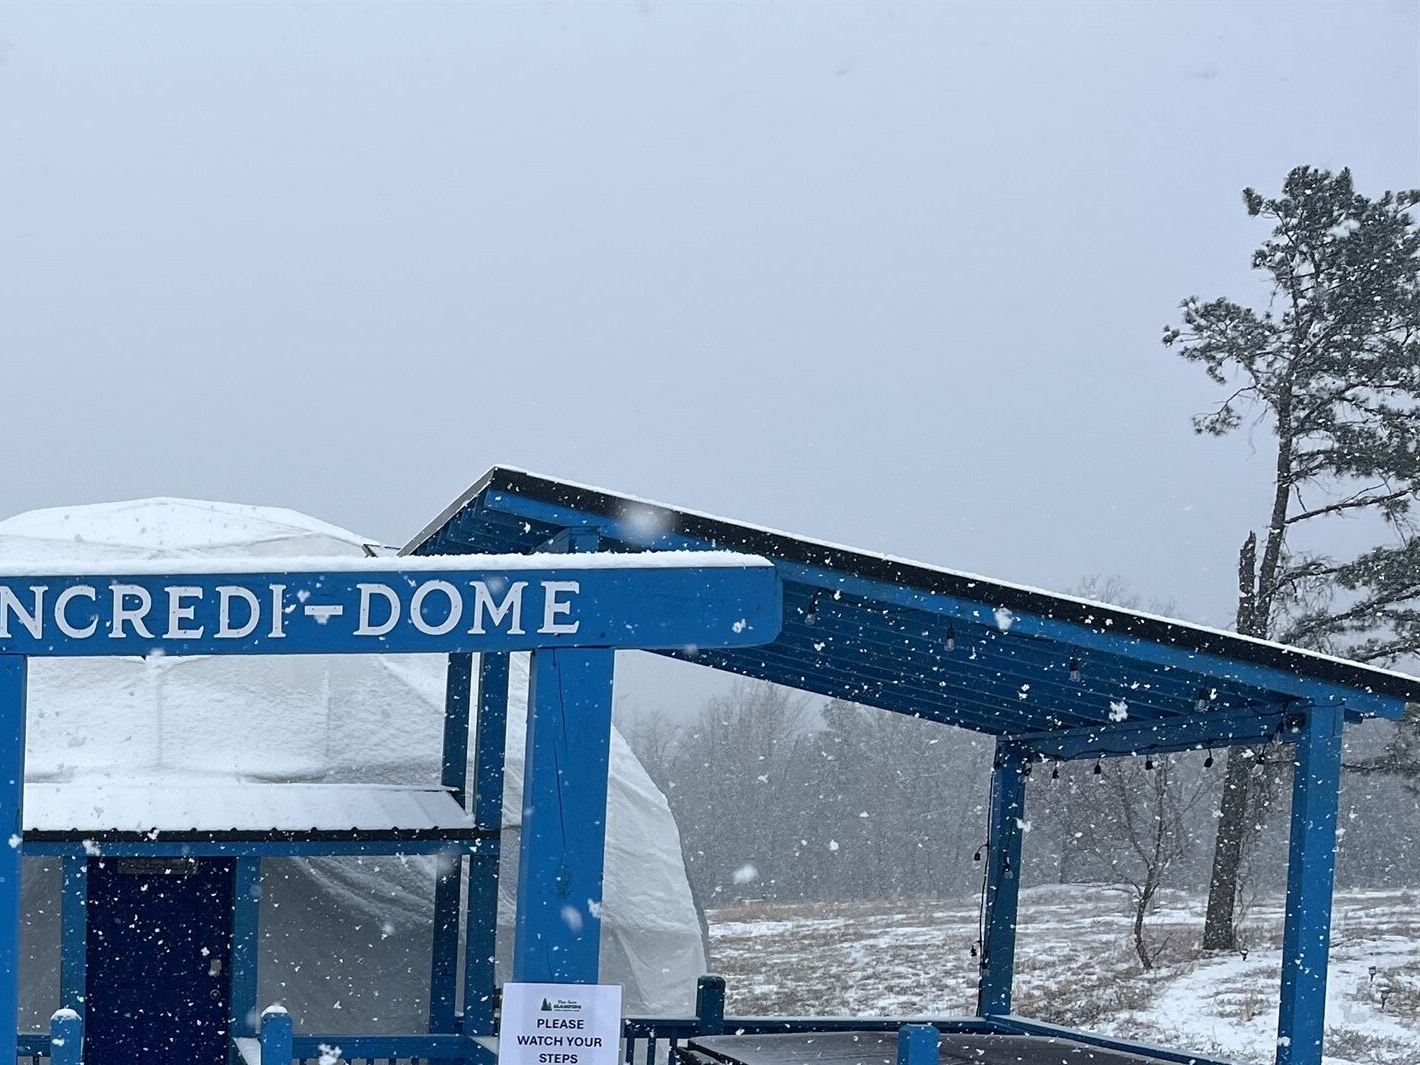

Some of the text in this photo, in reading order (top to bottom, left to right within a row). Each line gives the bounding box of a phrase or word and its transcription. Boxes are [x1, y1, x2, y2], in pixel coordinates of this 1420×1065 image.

[537, 1019, 584, 1029] PLEASE
[517, 1036, 601, 1047] WATCH YOUR
[539, 1054, 578, 1063] STEPS
